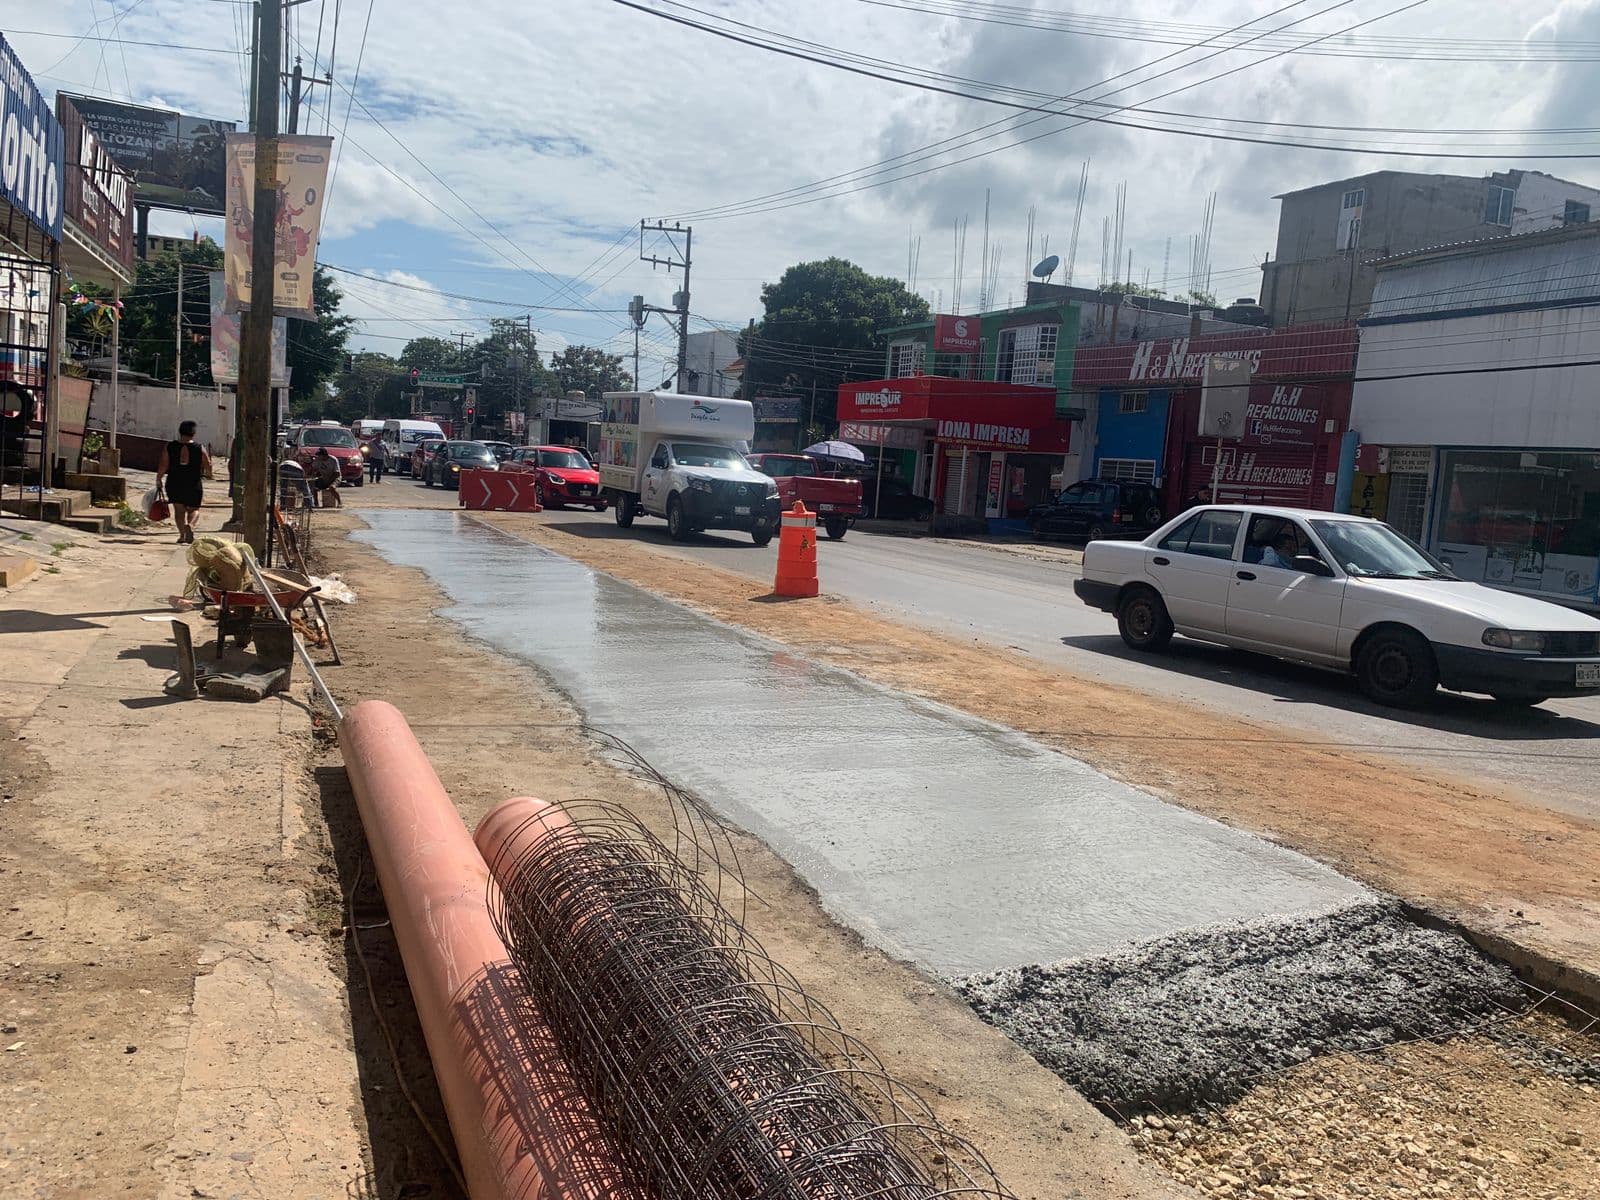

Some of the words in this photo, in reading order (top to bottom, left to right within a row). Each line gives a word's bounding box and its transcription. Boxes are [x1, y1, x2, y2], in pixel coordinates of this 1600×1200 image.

[942, 337, 977, 347] IMPRESUR
[855, 387, 902, 408] IMPRESUR
[1246, 403, 1319, 423] REFACCIONES
[937, 420, 971, 439] LONA
[973, 423, 1030, 446] IMPRESA
[1250, 466, 1313, 485] REFACCIONES
